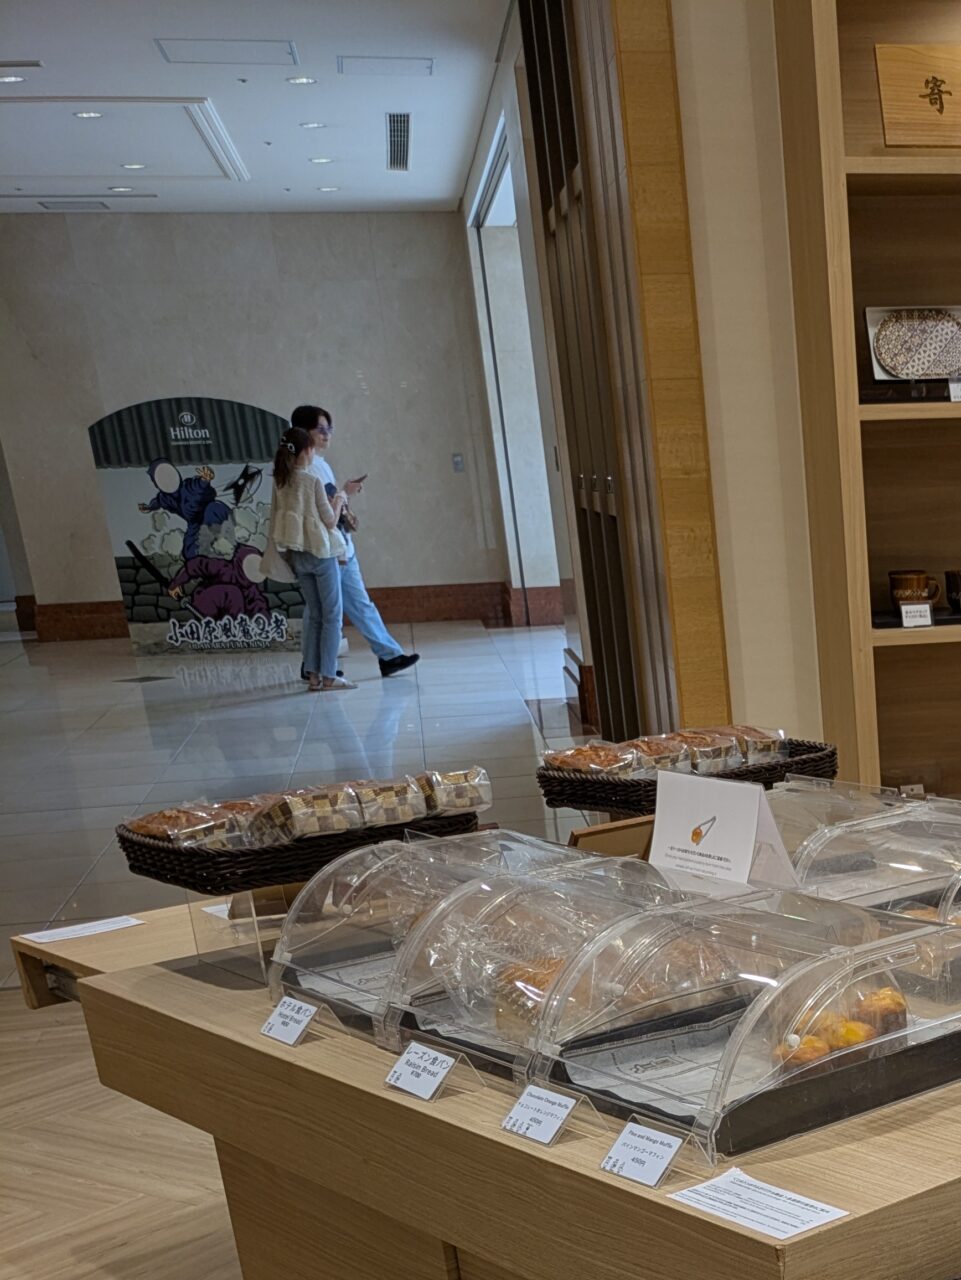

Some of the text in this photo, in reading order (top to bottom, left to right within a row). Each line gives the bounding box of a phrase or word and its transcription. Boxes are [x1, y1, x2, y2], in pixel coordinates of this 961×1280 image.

[170, 426, 210, 440] Hilton
[189, 641, 271, 649] ODAWARA FUMA NINJA
[280, 1000, 312, 1018] ホテル食パン
[289, 1015, 303, 1025] Bread
[406, 1047, 450, 1070] レーズン食パン
[405, 1058, 439, 1078] Raisin Bread
[543, 1097, 557, 1107] Orange
[645, 1135, 659, 1145] Mango
[659, 1140, 673, 1149] Muffin
[621, 1142, 664, 1160] パインマンゴーマフィン
